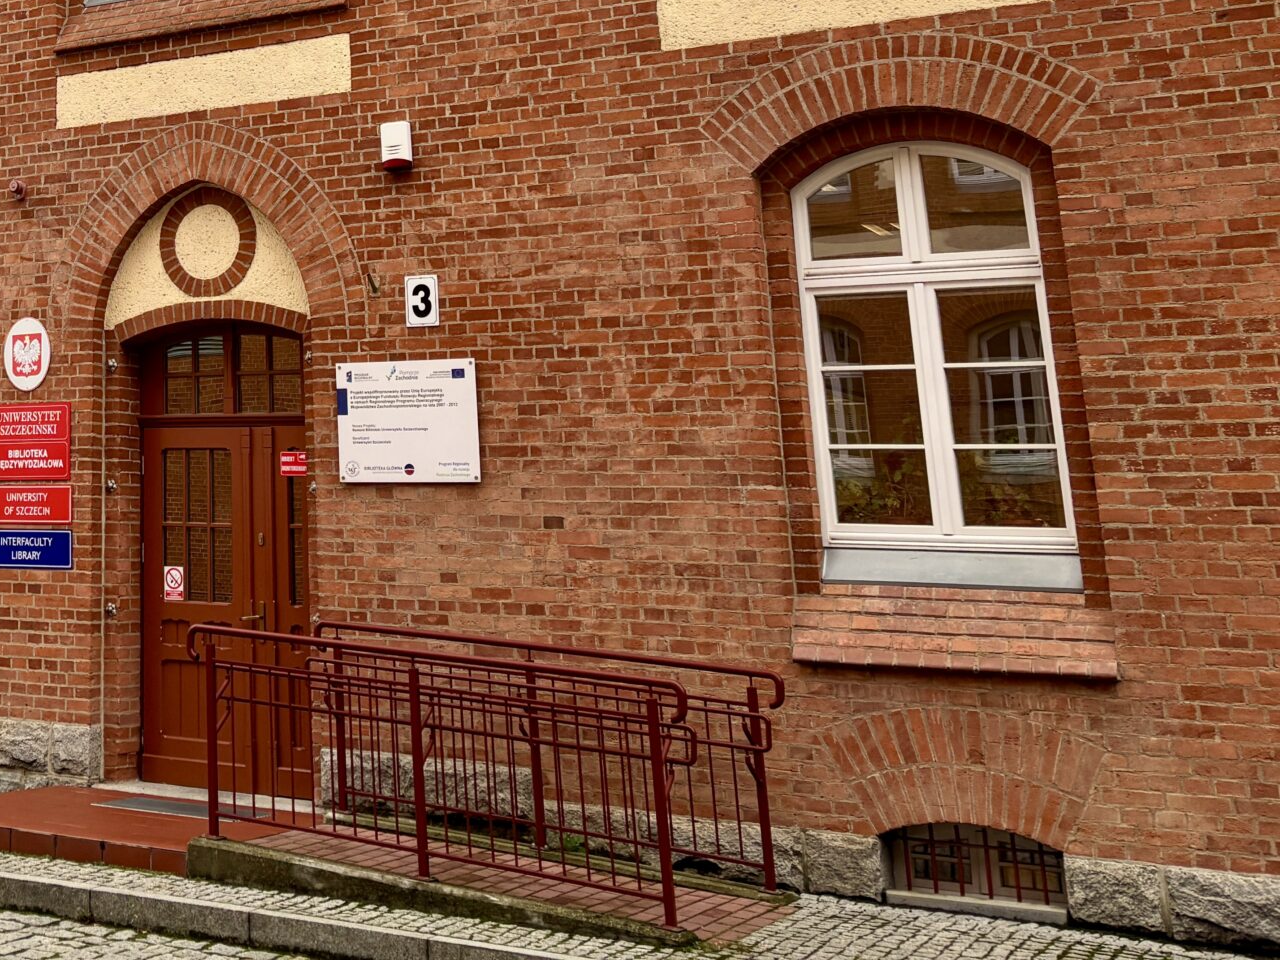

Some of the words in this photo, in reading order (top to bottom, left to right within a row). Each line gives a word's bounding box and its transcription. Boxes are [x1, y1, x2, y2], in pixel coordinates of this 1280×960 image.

[412, 284, 432, 318] 3
[0, 422, 57, 435] SZCZECIŃSKI
[8, 449, 48, 458] BIBLIOTEKA
[6, 493, 48, 501] UNIVERSITY
[4, 506, 13, 515] OF
[16, 506, 50, 515] SZCZECIN
[0, 536, 53, 546] INTERFACULTY
[11, 550, 41, 560] LIBRARY
